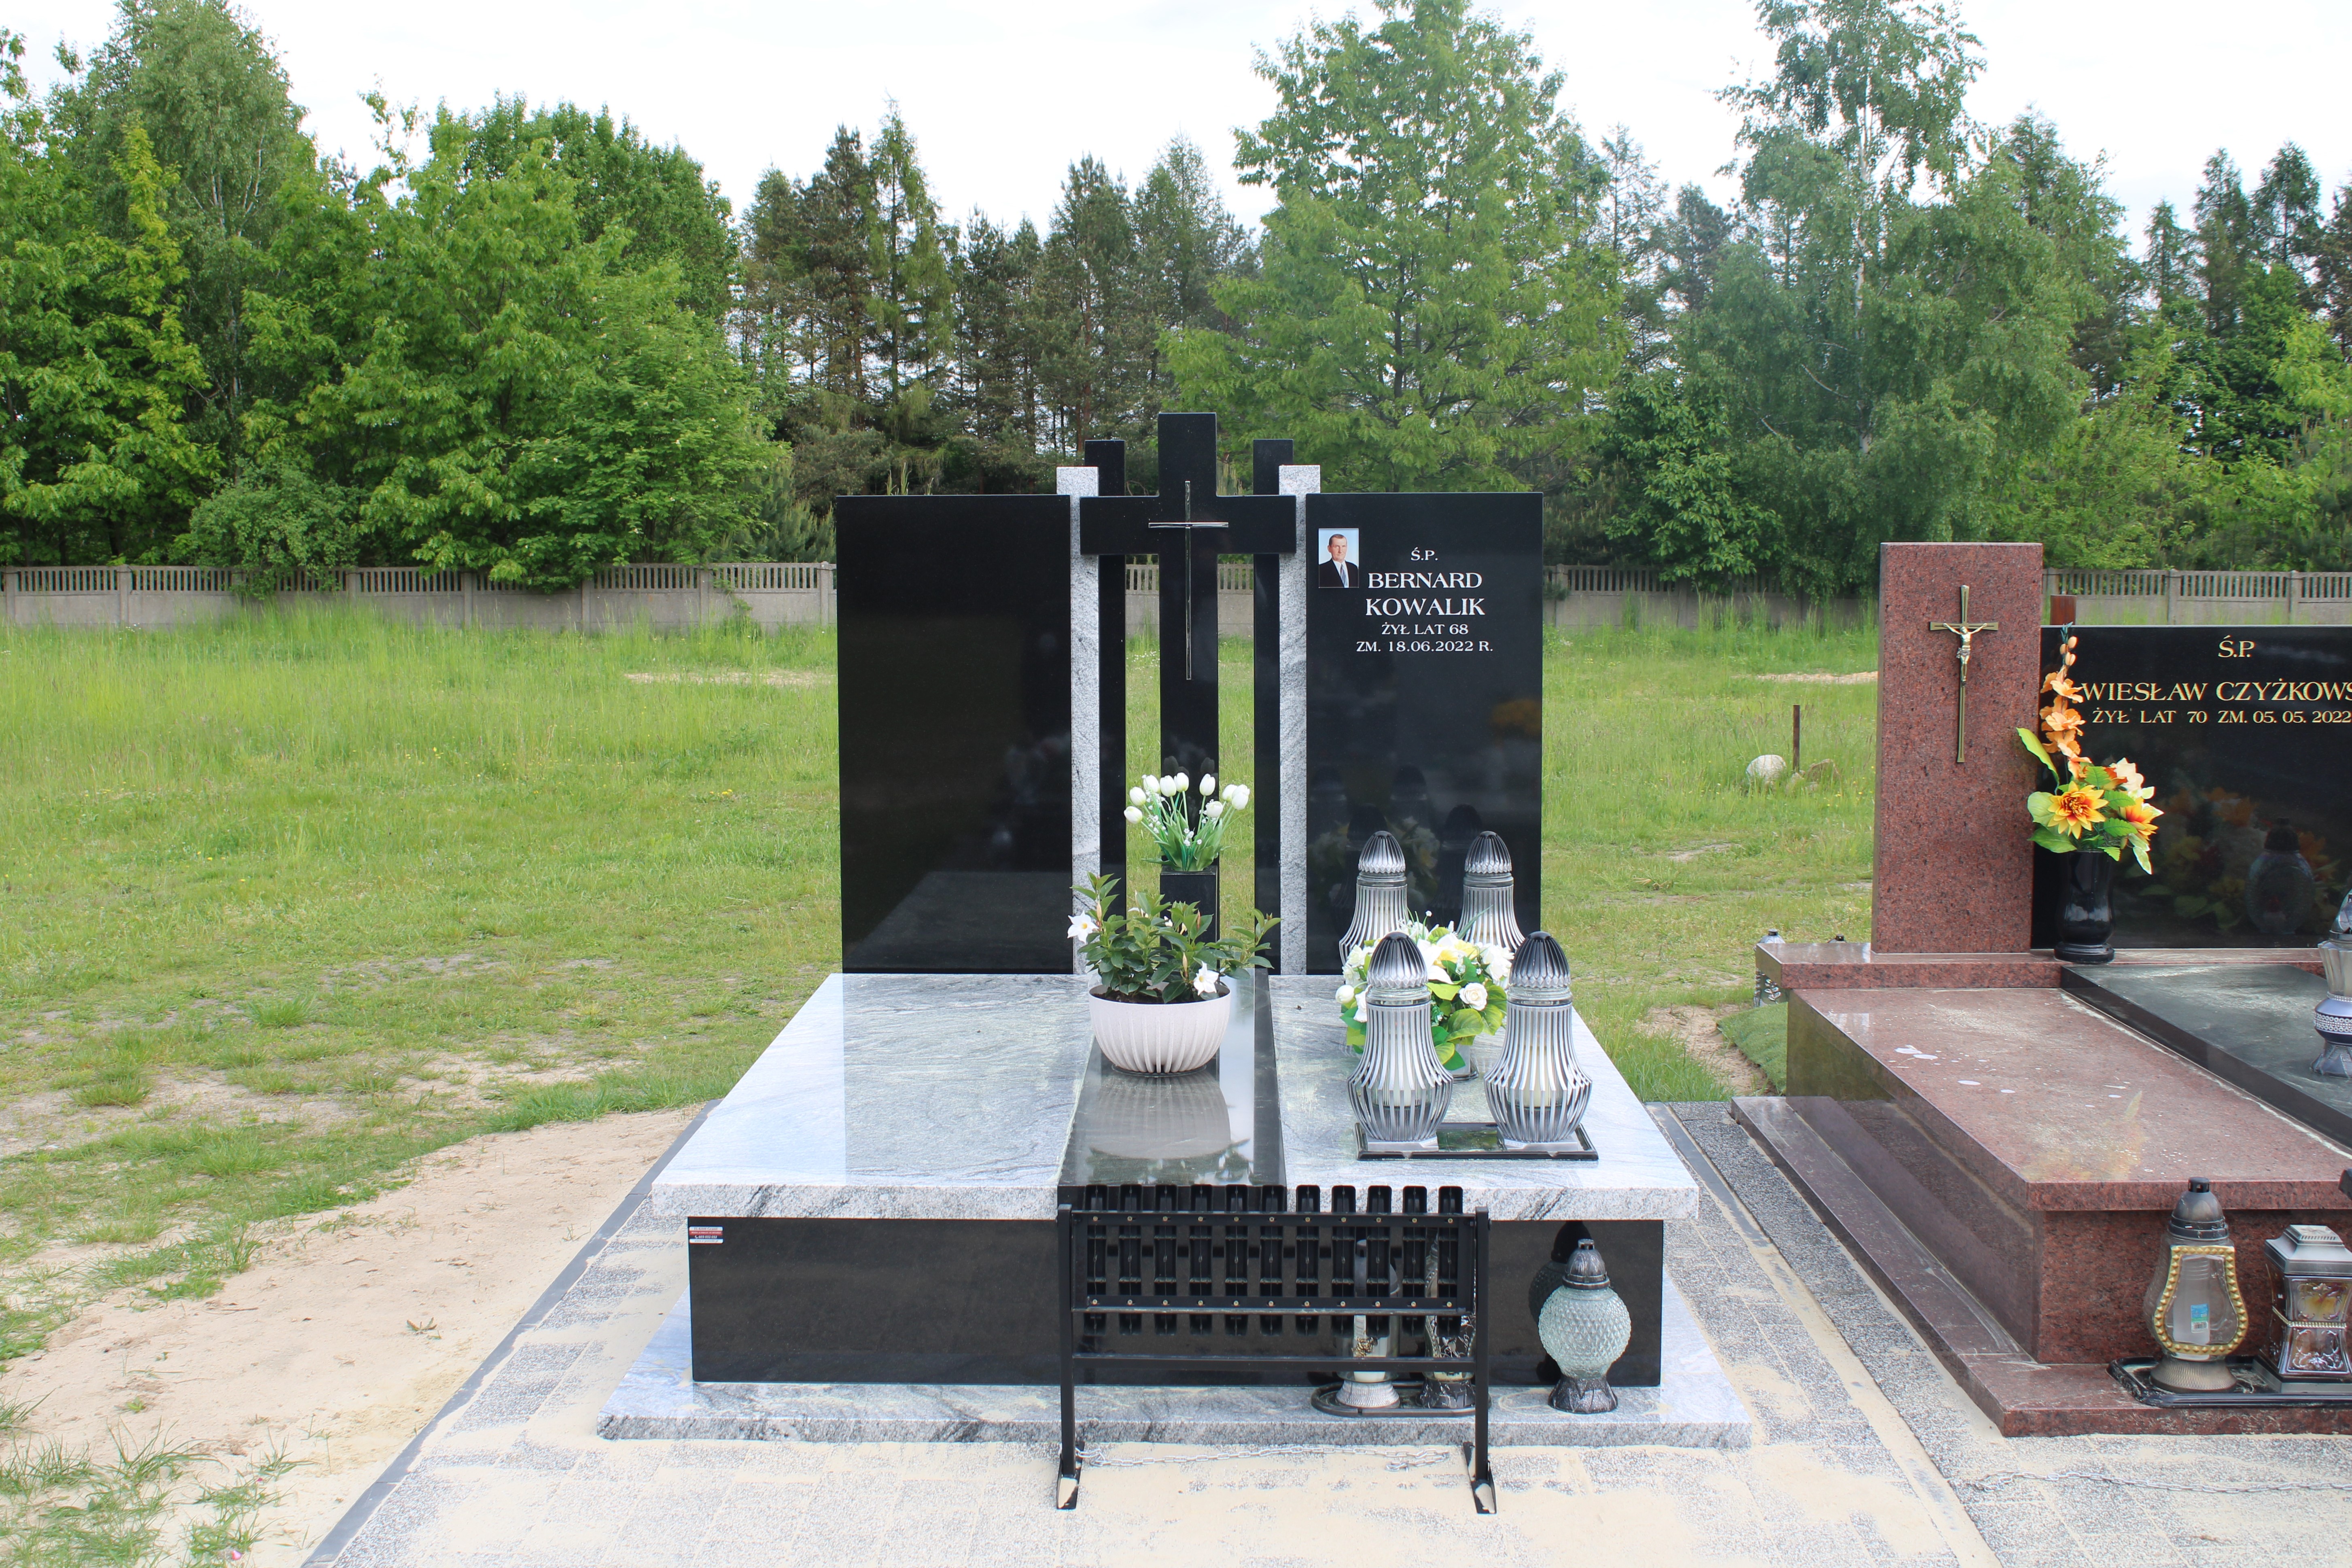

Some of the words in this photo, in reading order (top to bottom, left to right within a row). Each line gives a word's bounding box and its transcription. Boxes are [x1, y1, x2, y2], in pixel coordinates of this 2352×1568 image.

[1411, 547, 1438, 560] Ś.P.
[1368, 573, 1482, 588] BERNARD
[1366, 598, 1485, 615] KOWALIK
[1382, 622, 1410, 634] ŻYŁ
[1415, 624, 1445, 634] LAT
[1449, 624, 1468, 634] 68
[1357, 642, 1381, 651] ZM.
[1389, 641, 1473, 651] 18.06.2022
[1479, 641, 1493, 651] R.
[2218, 635, 2255, 657] Ś.P.
[2081, 682, 2208, 701] WIESŁAW
[2092, 707, 2129, 723] ŻYŁ
[2140, 711, 2176, 723] LAT
[2187, 711, 2208, 723] 70
[2218, 711, 2247, 723] ZM.
[2312, 711, 2352, 723] 2022
